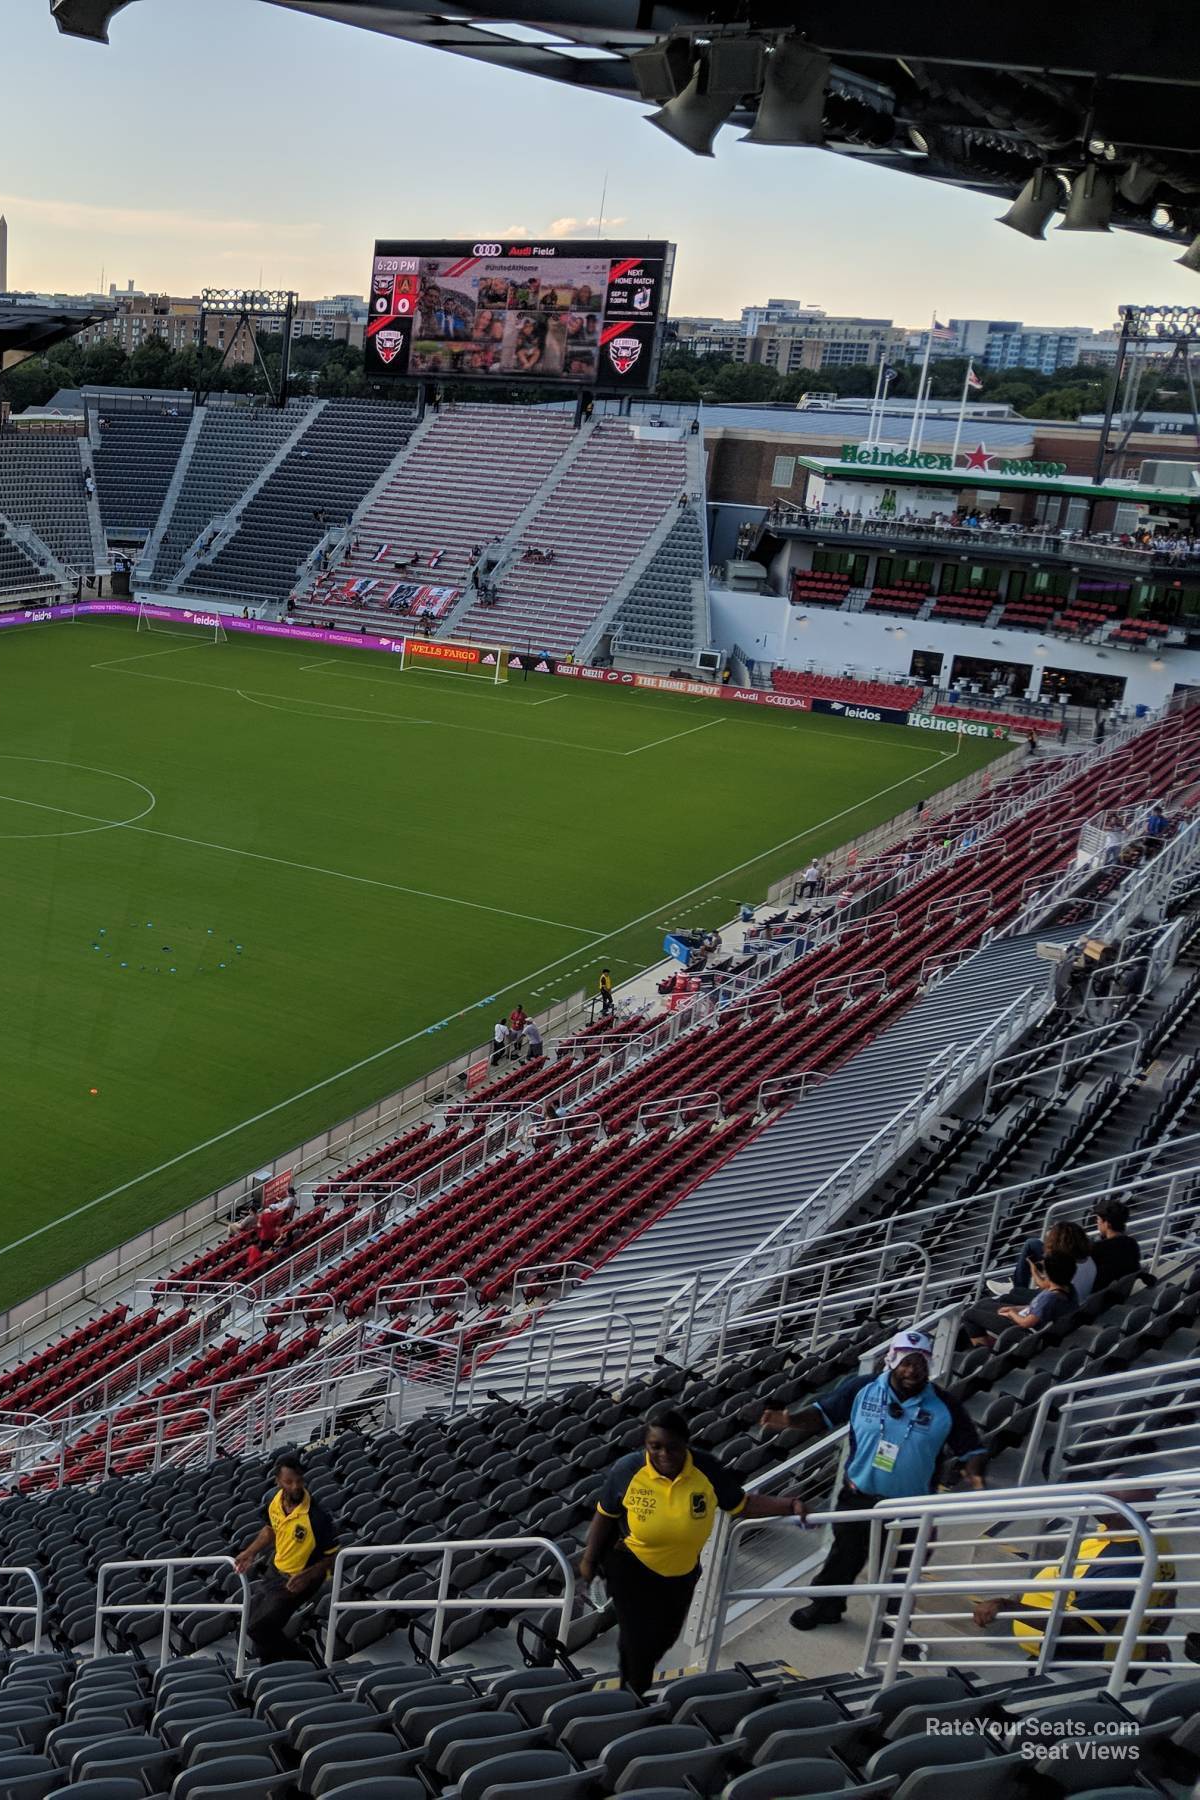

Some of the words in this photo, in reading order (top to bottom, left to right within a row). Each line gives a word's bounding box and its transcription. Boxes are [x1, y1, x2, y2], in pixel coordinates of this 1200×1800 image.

[508, 247, 532, 255] Audi
[533, 247, 555, 255] Field
[377, 260, 398, 270] 6:20
[400, 260, 416, 271] PM
[627, 269, 644, 277] NEXT
[614, 277, 632, 285] HOME
[375, 297, 388, 313] 0
[397, 298, 410, 313] 0
[840, 444, 954, 471] Heineken
[1000, 459, 1067, 478] ROOFTOP
[193, 613, 220, 627] leidos
[411, 644, 442, 656] WELLS
[444, 649, 476, 660] FARGO
[636, 675, 657, 688] THE
[658, 678, 685, 692] HOME
[686, 681, 720, 696] DEPOT
[733, 690, 759, 702] Audi
[844, 706, 881, 722] leidos
[906, 712, 989, 737] Heineken
[631, 1487, 654, 1496] EVENT
[629, 1496, 657, 1509] 3752
